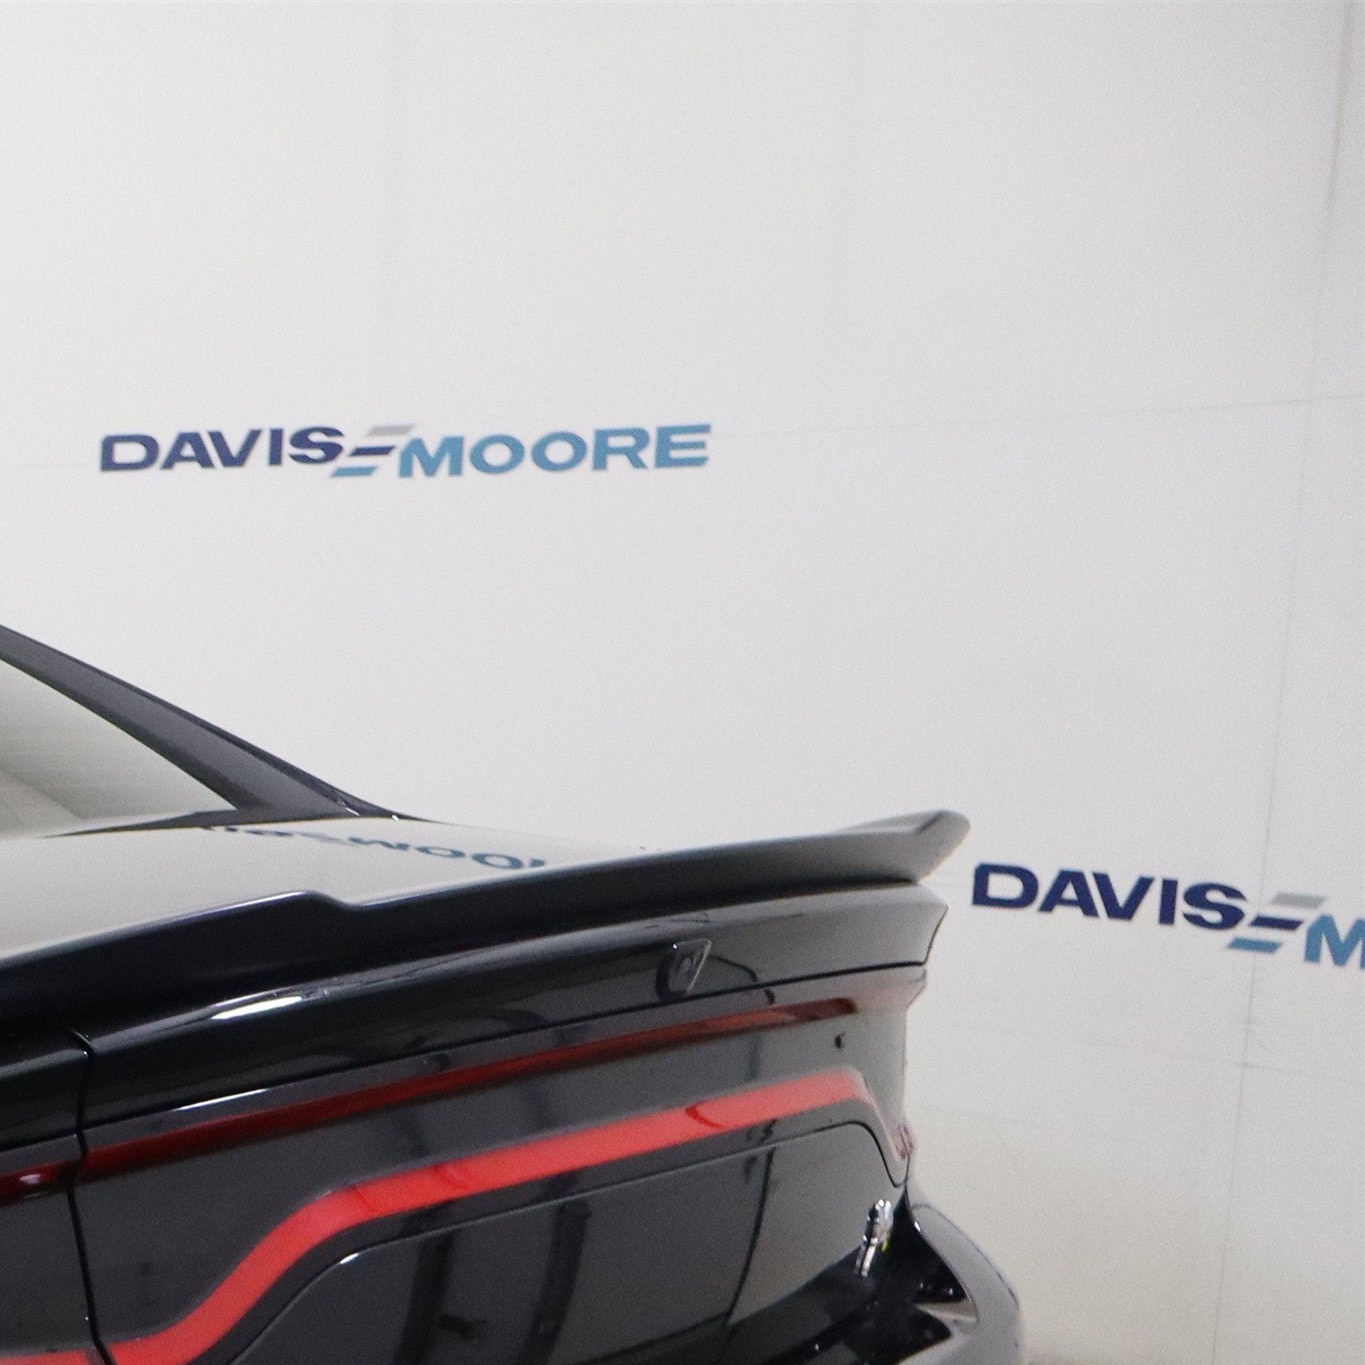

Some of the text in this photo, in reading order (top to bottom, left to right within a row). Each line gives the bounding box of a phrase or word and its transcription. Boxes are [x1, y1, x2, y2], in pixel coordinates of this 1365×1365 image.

[99, 423, 712, 478] DAVIS MOORE
[971, 862, 1248, 931] DAVIS
